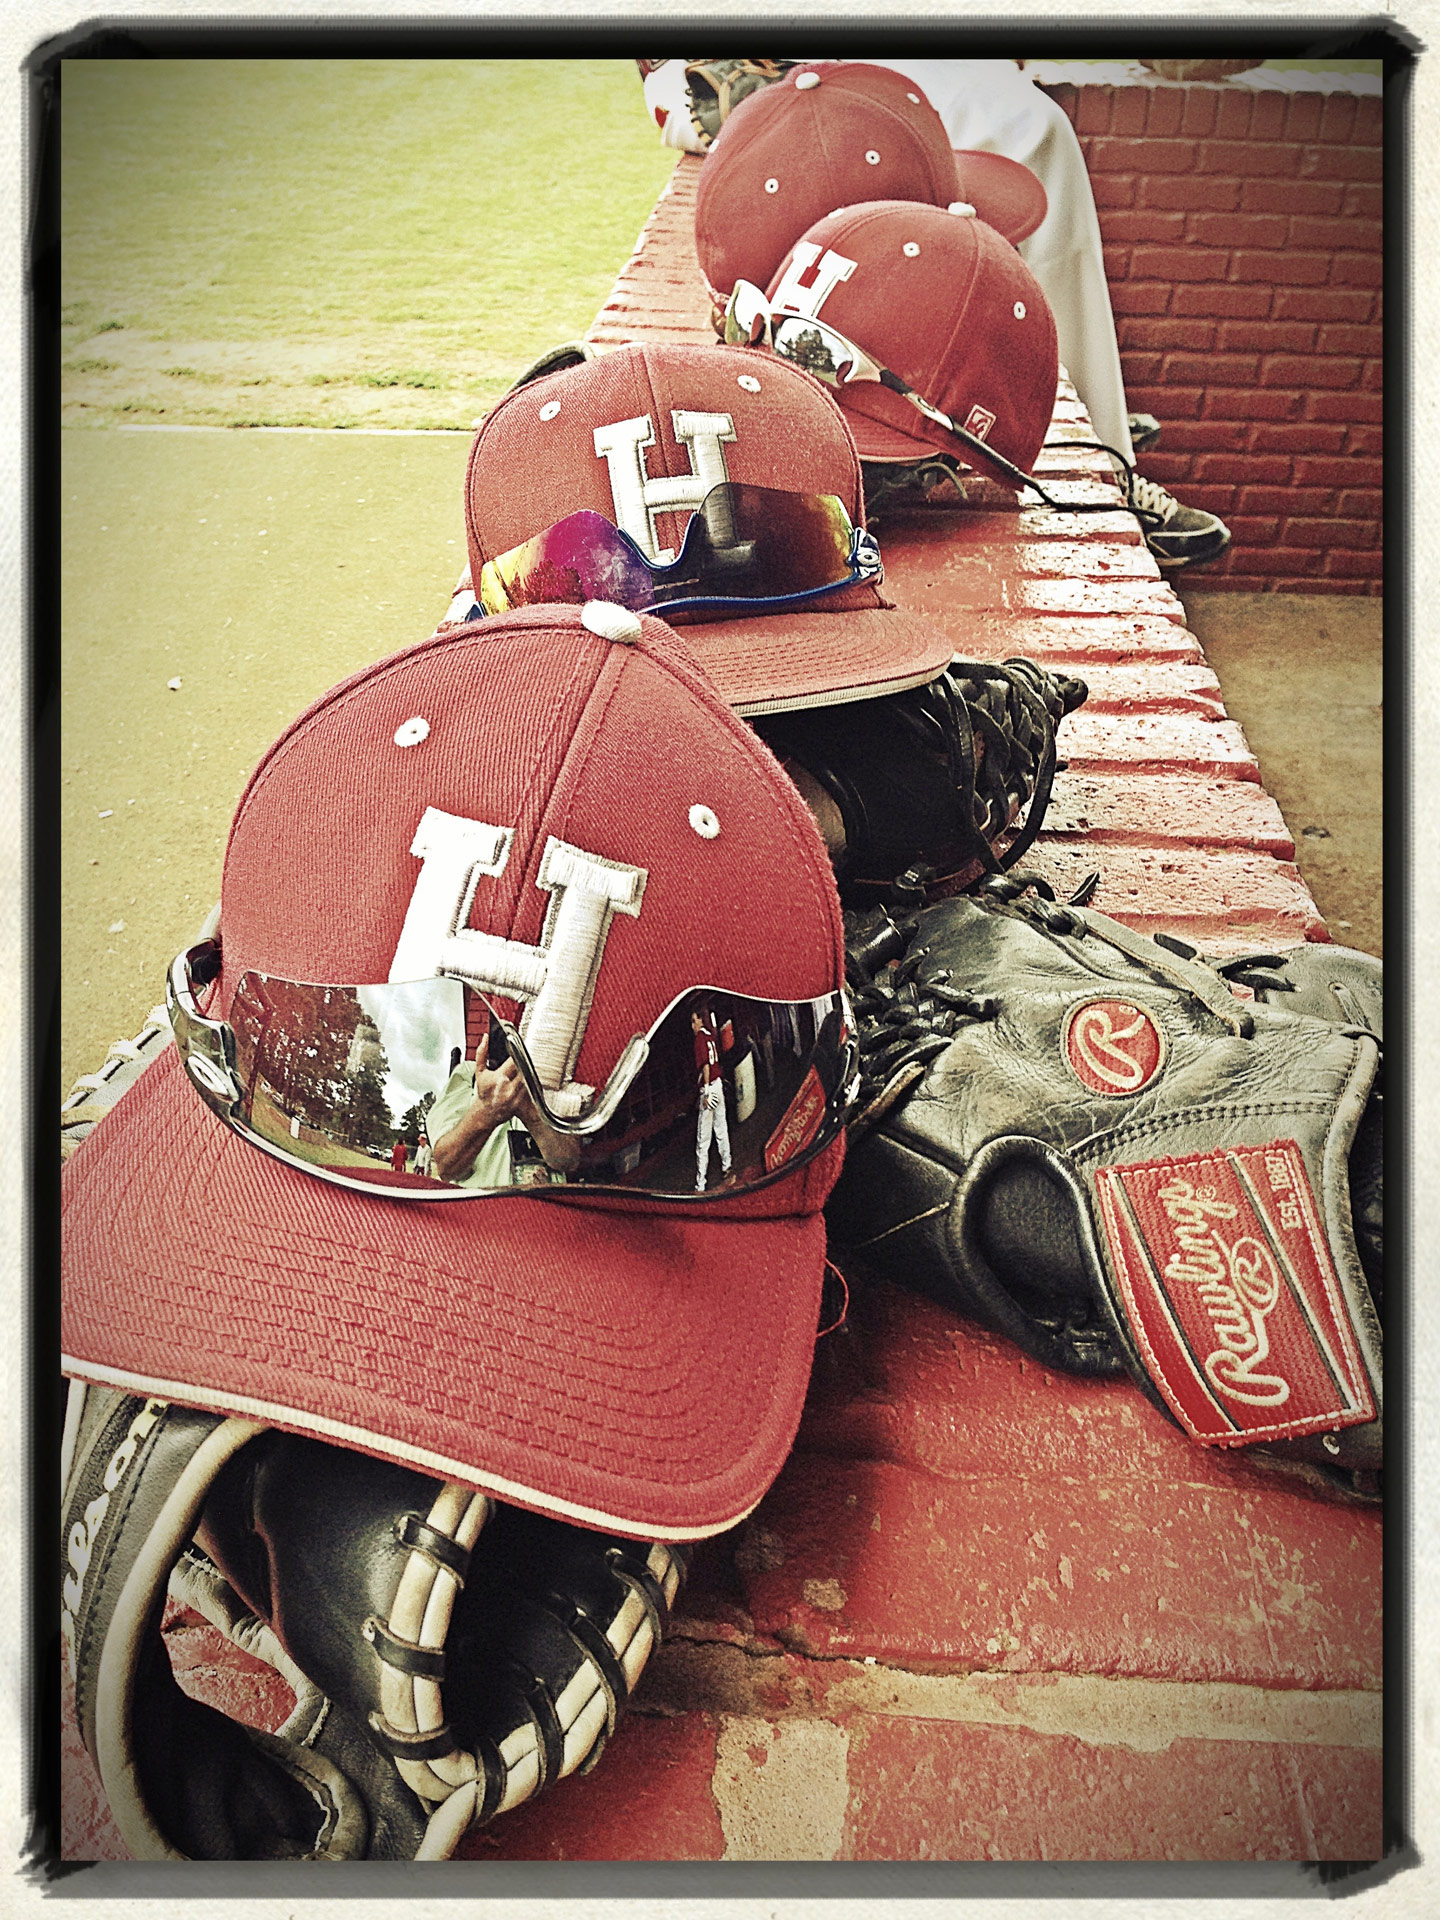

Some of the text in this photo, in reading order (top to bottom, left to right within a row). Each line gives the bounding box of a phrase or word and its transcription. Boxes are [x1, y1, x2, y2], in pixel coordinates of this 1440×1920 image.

[769, 241, 858, 317] H
[593, 410, 752, 568] H
[388, 805, 649, 1117] H
[1075, 1009, 1146, 1089] R
[1265, 1156, 1291, 1191] 1887
[1157, 1176, 1290, 1406] Rawlings
[62, 1398, 169, 1640] ilson
